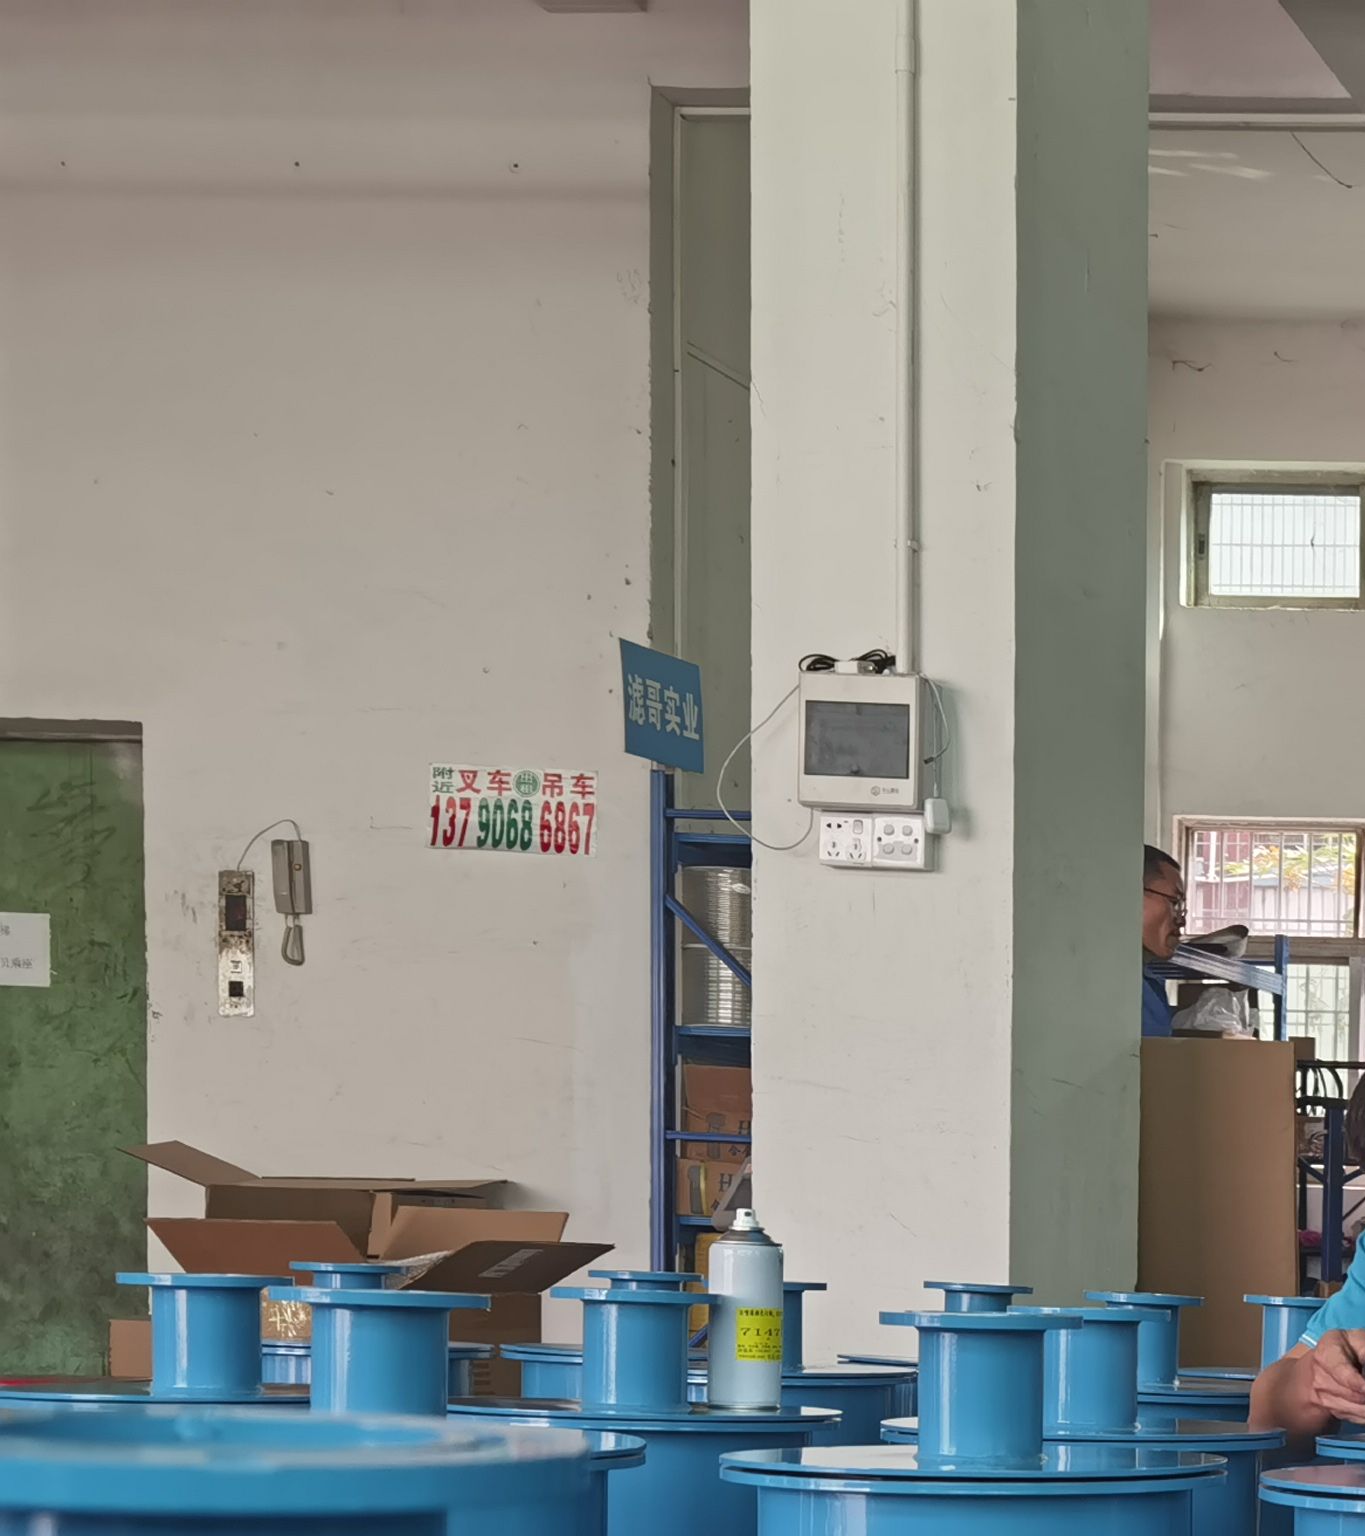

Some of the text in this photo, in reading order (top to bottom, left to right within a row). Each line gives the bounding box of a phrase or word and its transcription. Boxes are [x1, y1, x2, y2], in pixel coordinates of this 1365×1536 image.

[627, 673, 700, 741] 滤哥实业
[432, 766, 455, 794] 附近
[456, 769, 513, 797] 叉车
[541, 772, 595, 800] 吊车
